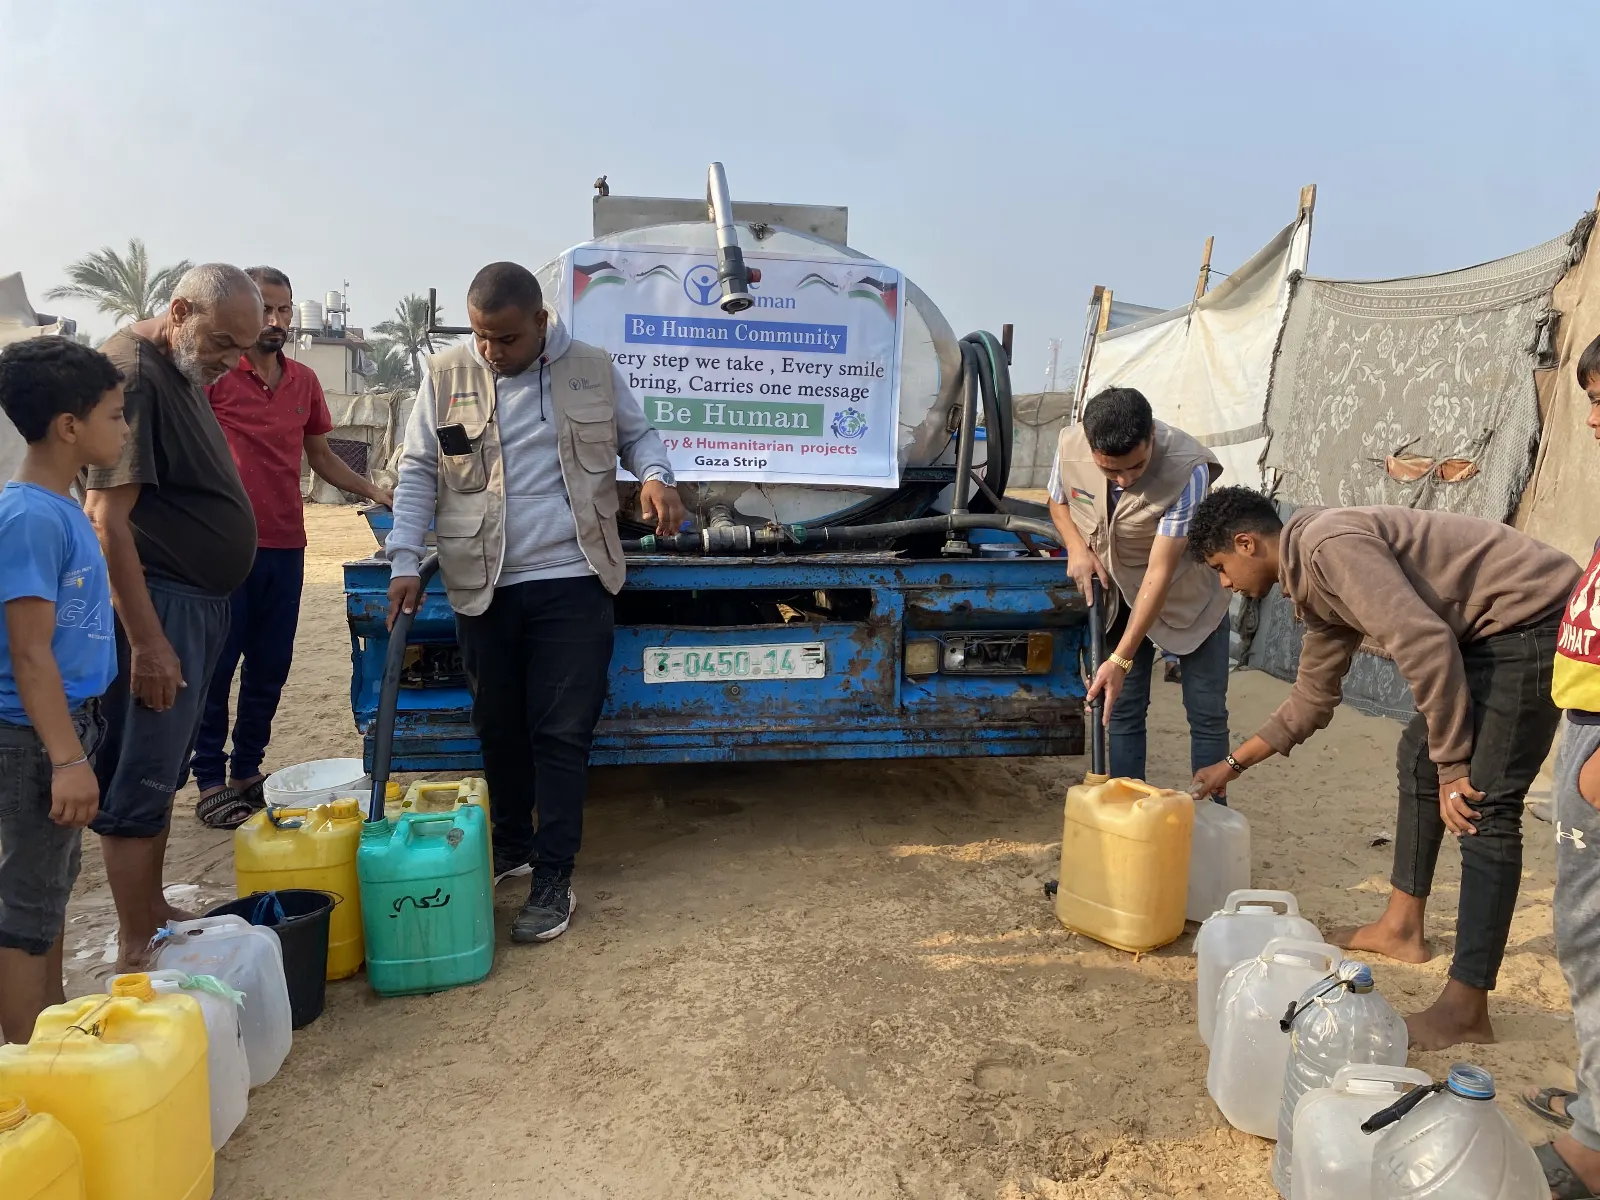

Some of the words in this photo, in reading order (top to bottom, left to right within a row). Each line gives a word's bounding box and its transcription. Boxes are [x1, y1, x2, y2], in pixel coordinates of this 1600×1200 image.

[752, 295, 796, 309] man
[631, 318, 656, 337] Be
[661, 320, 729, 340] Human
[735, 323, 842, 350] Community
[609, 353, 647, 370] very
[653, 353, 689, 372] step
[695, 357, 721, 370] we
[726, 356, 764, 372] take
[781, 357, 834, 379] Every
[838, 361, 885, 378] smile
[629, 373, 682, 394] bring,
[689, 375, 754, 394] Carries
[759, 382, 792, 396] one
[797, 384, 870, 402] message
[653, 400, 692, 424] Be
[702, 403, 810, 429] Human
[682, 436, 693, 448] &
[696, 437, 794, 453] Humanitarian
[801, 442, 857, 455] projects
[694, 455, 730, 467] Gaza
[733, 456, 768, 469] Strip
[1559, 621, 1597, 656] WHAT
